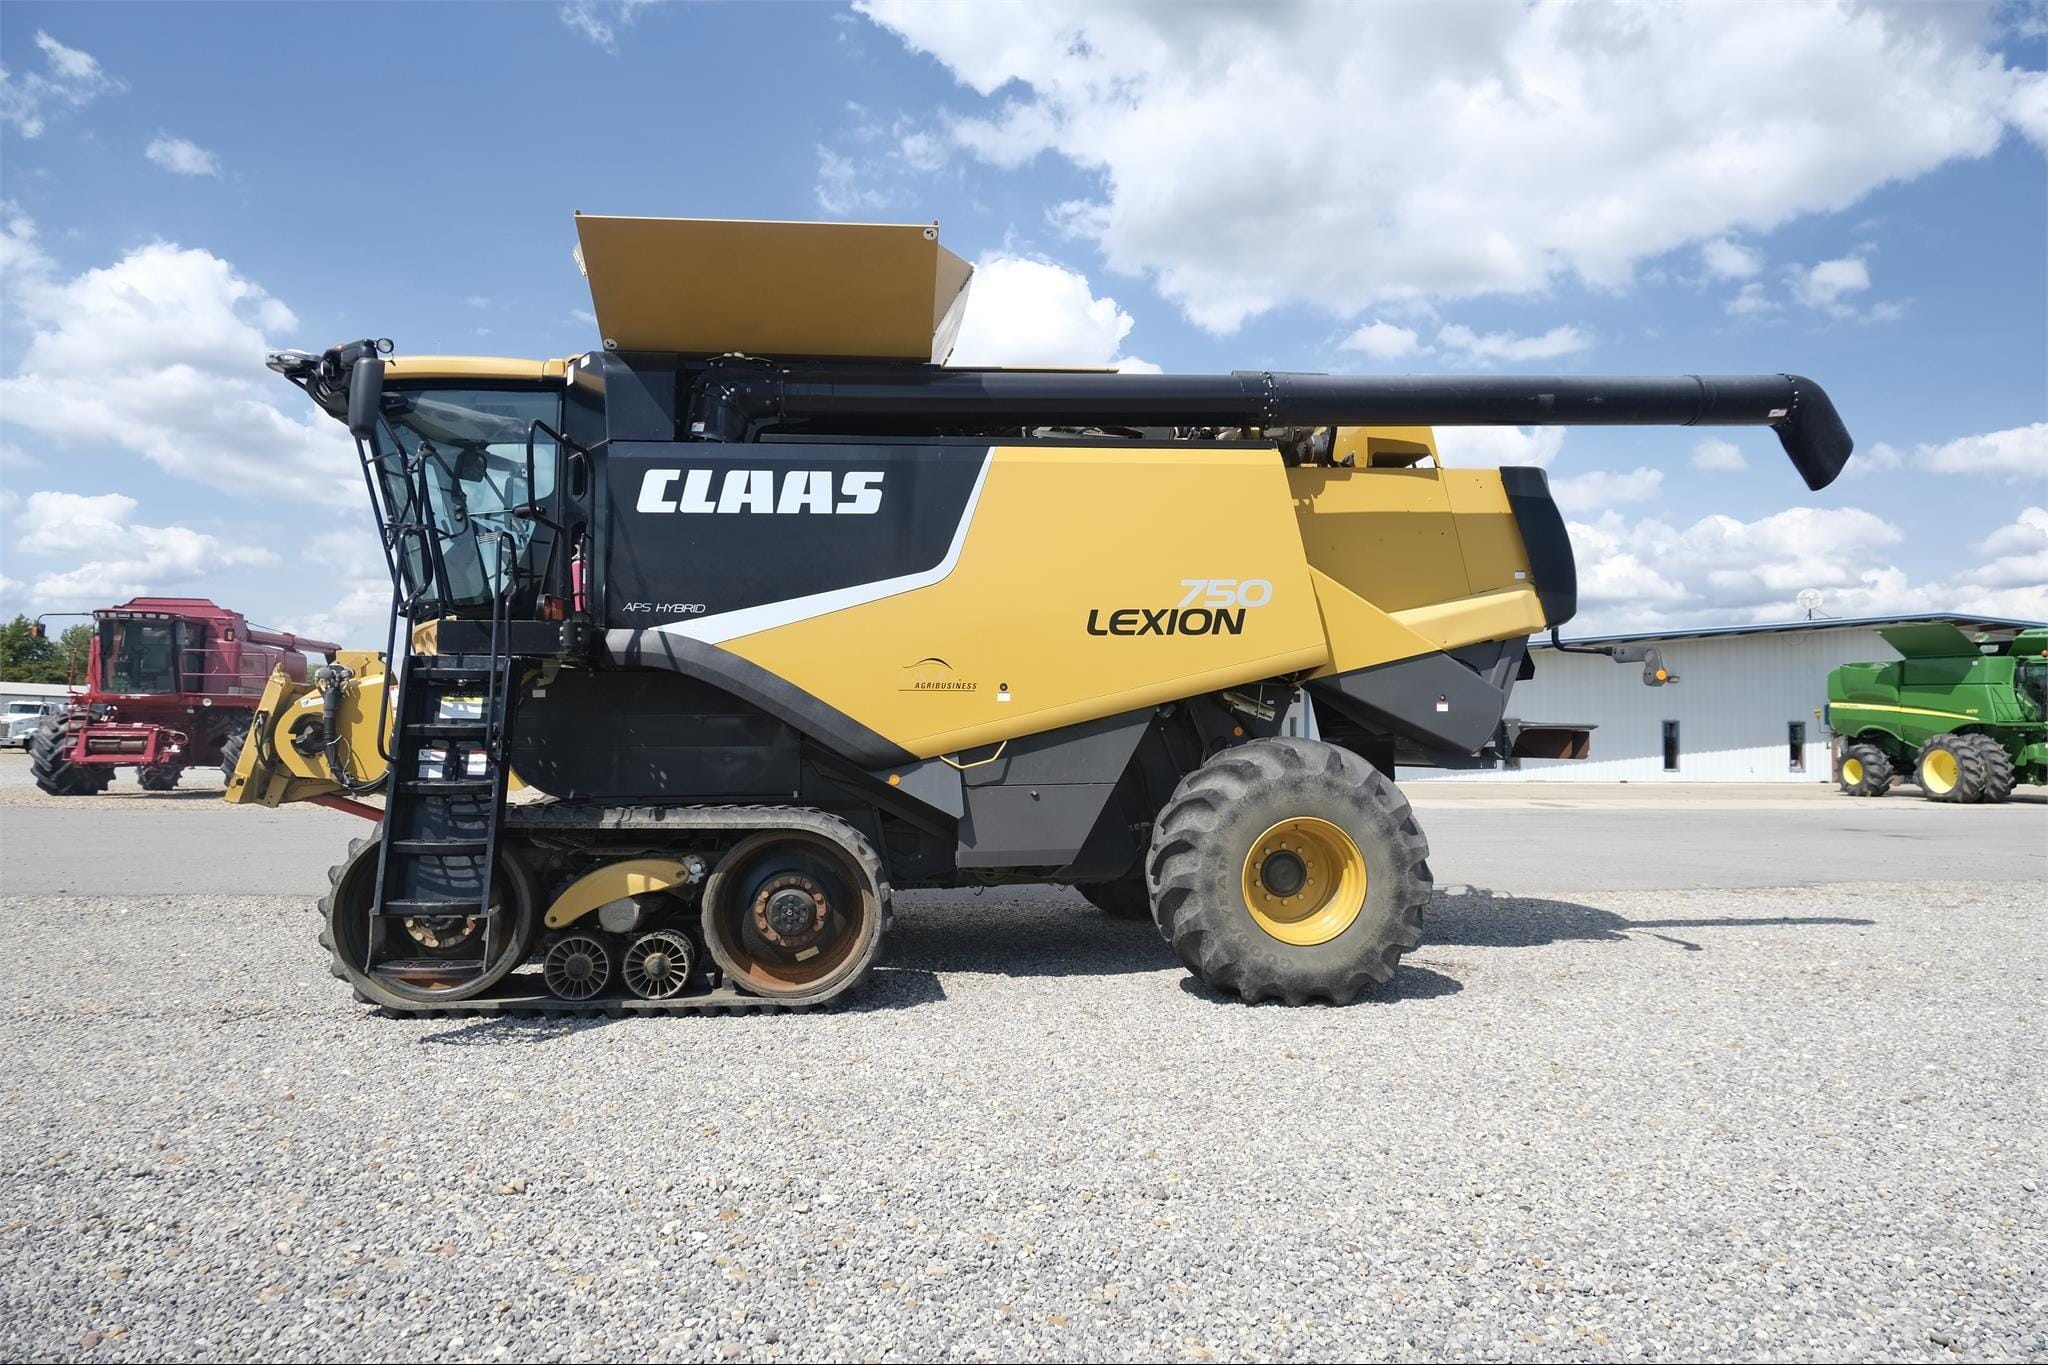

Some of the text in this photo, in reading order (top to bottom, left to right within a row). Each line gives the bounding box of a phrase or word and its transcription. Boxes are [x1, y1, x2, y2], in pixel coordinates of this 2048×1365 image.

[636, 469, 885, 514] CLAAS
[1177, 579, 1272, 607] 750
[622, 602, 706, 614] APS HYBRID
[1087, 608, 1246, 635] LEXION
[914, 682, 977, 690] AGRIBUSINESS
